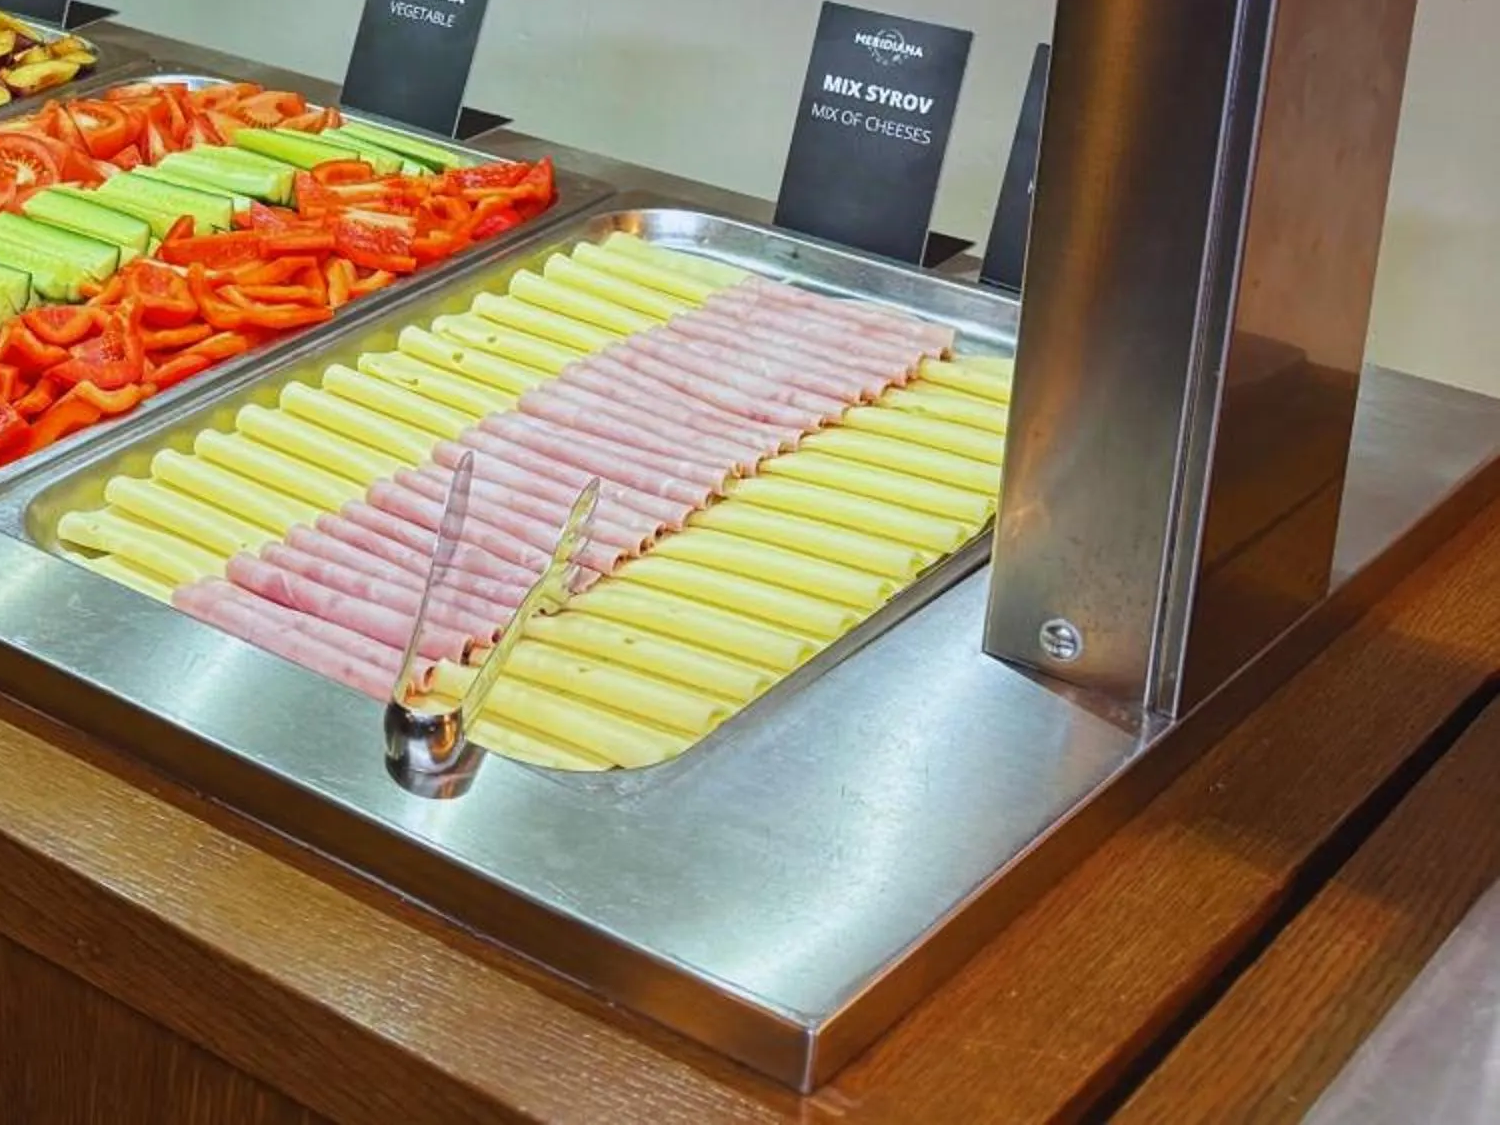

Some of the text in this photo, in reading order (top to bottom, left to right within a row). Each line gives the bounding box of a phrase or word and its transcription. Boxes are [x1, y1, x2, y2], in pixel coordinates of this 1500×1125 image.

[390, 0, 456, 27] VEGETABLE
[854, 33, 923, 57] MERIDIANA
[823, 74, 934, 114] MIX SYROV
[811, 103, 932, 144] MIX OF CHEESES
